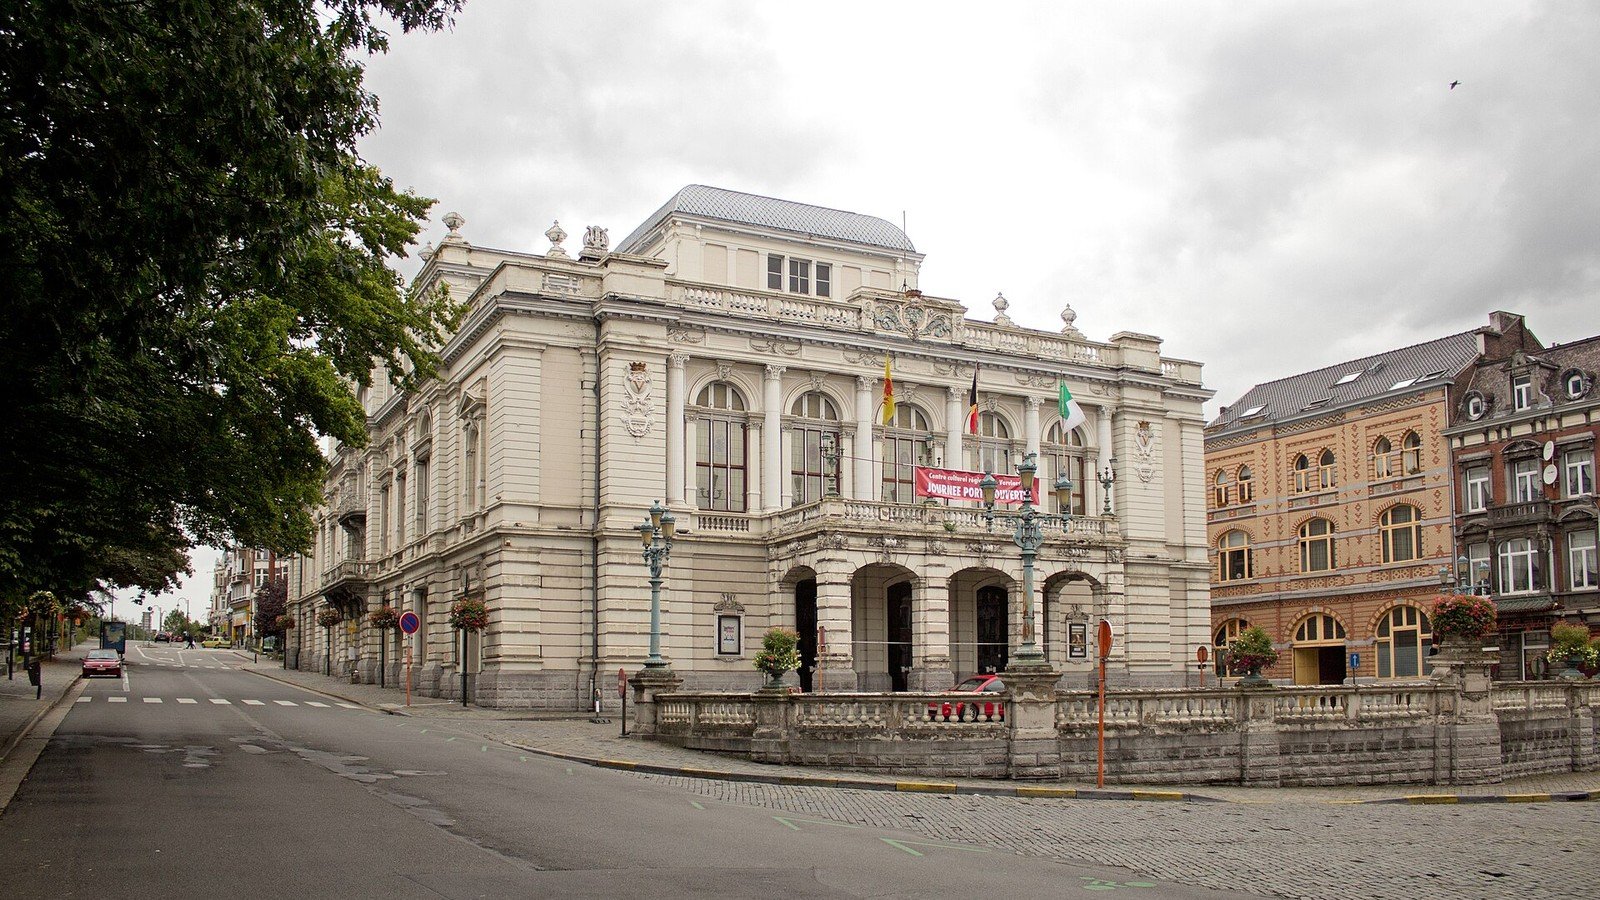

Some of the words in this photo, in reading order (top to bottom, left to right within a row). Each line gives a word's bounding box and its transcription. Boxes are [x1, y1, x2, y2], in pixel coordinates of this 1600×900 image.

[929, 472, 947, 480] Centre
[947, 474, 968, 482] culturel
[927, 482, 962, 497] JOURNEE
[963, 486, 983, 499] PORT
[994, 489, 1032, 502] OUVERT
